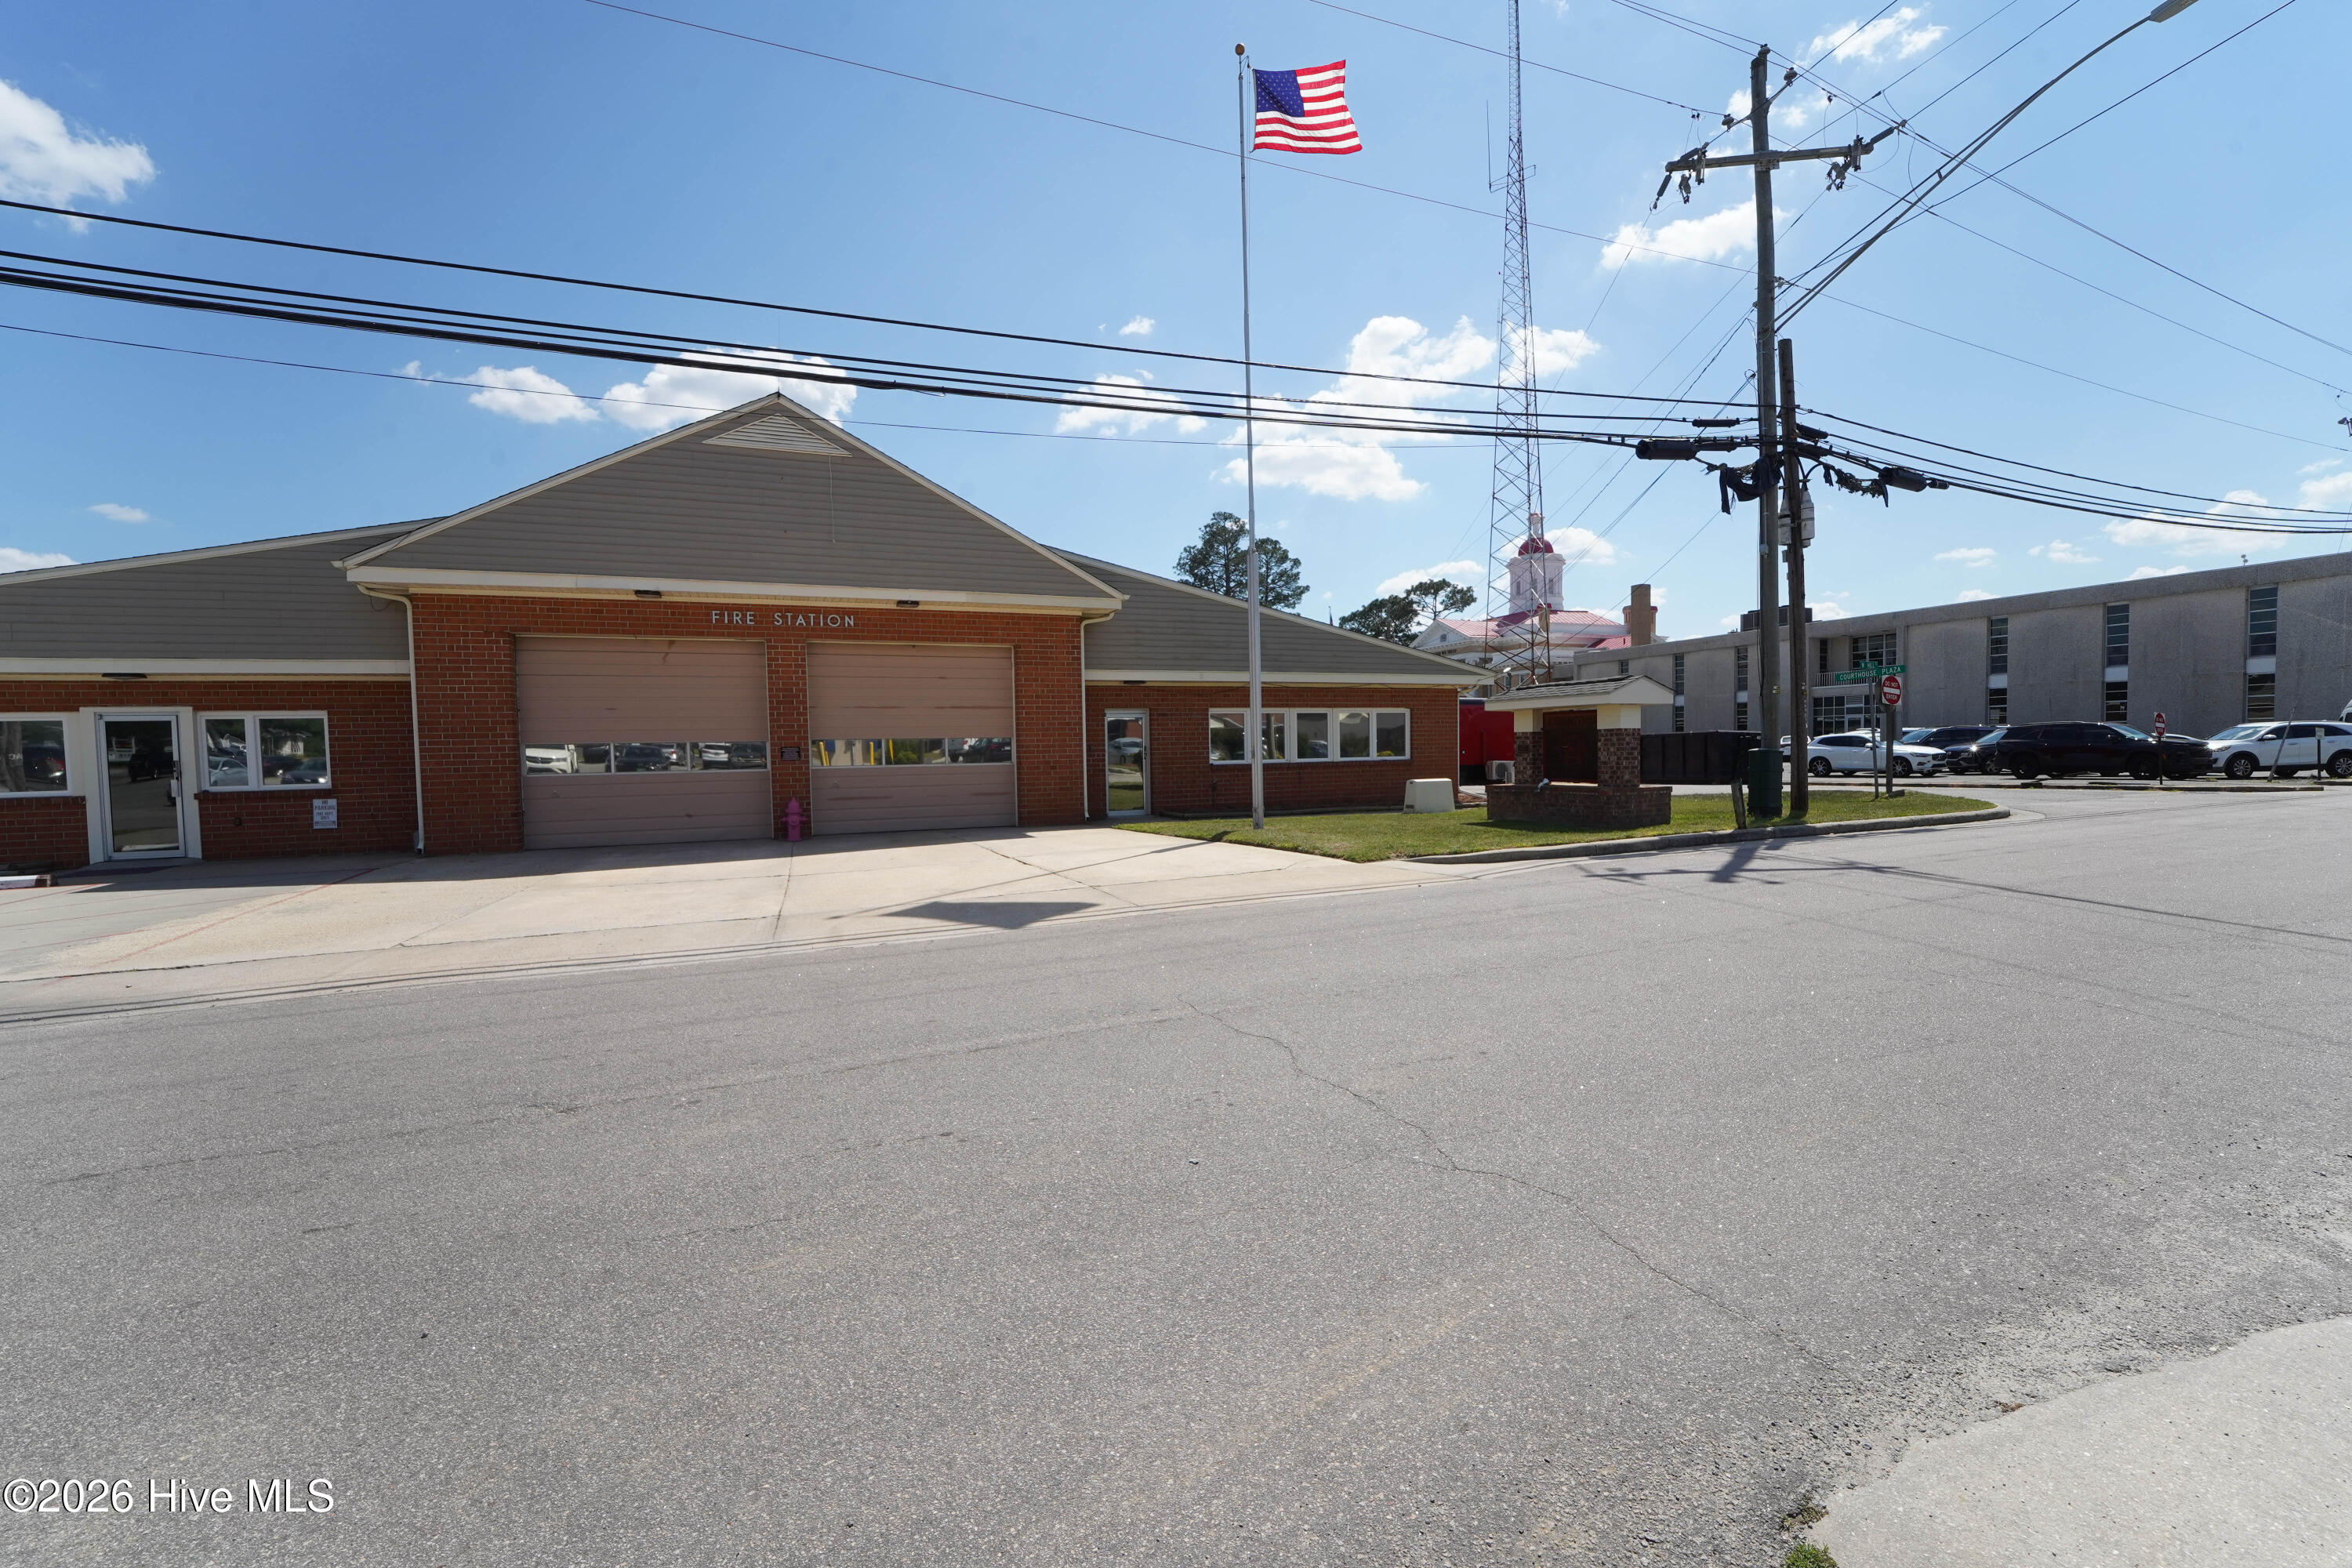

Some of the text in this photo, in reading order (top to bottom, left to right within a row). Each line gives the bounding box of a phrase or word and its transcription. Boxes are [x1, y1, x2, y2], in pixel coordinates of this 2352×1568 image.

[712, 611, 855, 627] FIRE STATION
[1839, 666, 1901, 681] COURTHOUSE PLAZA
